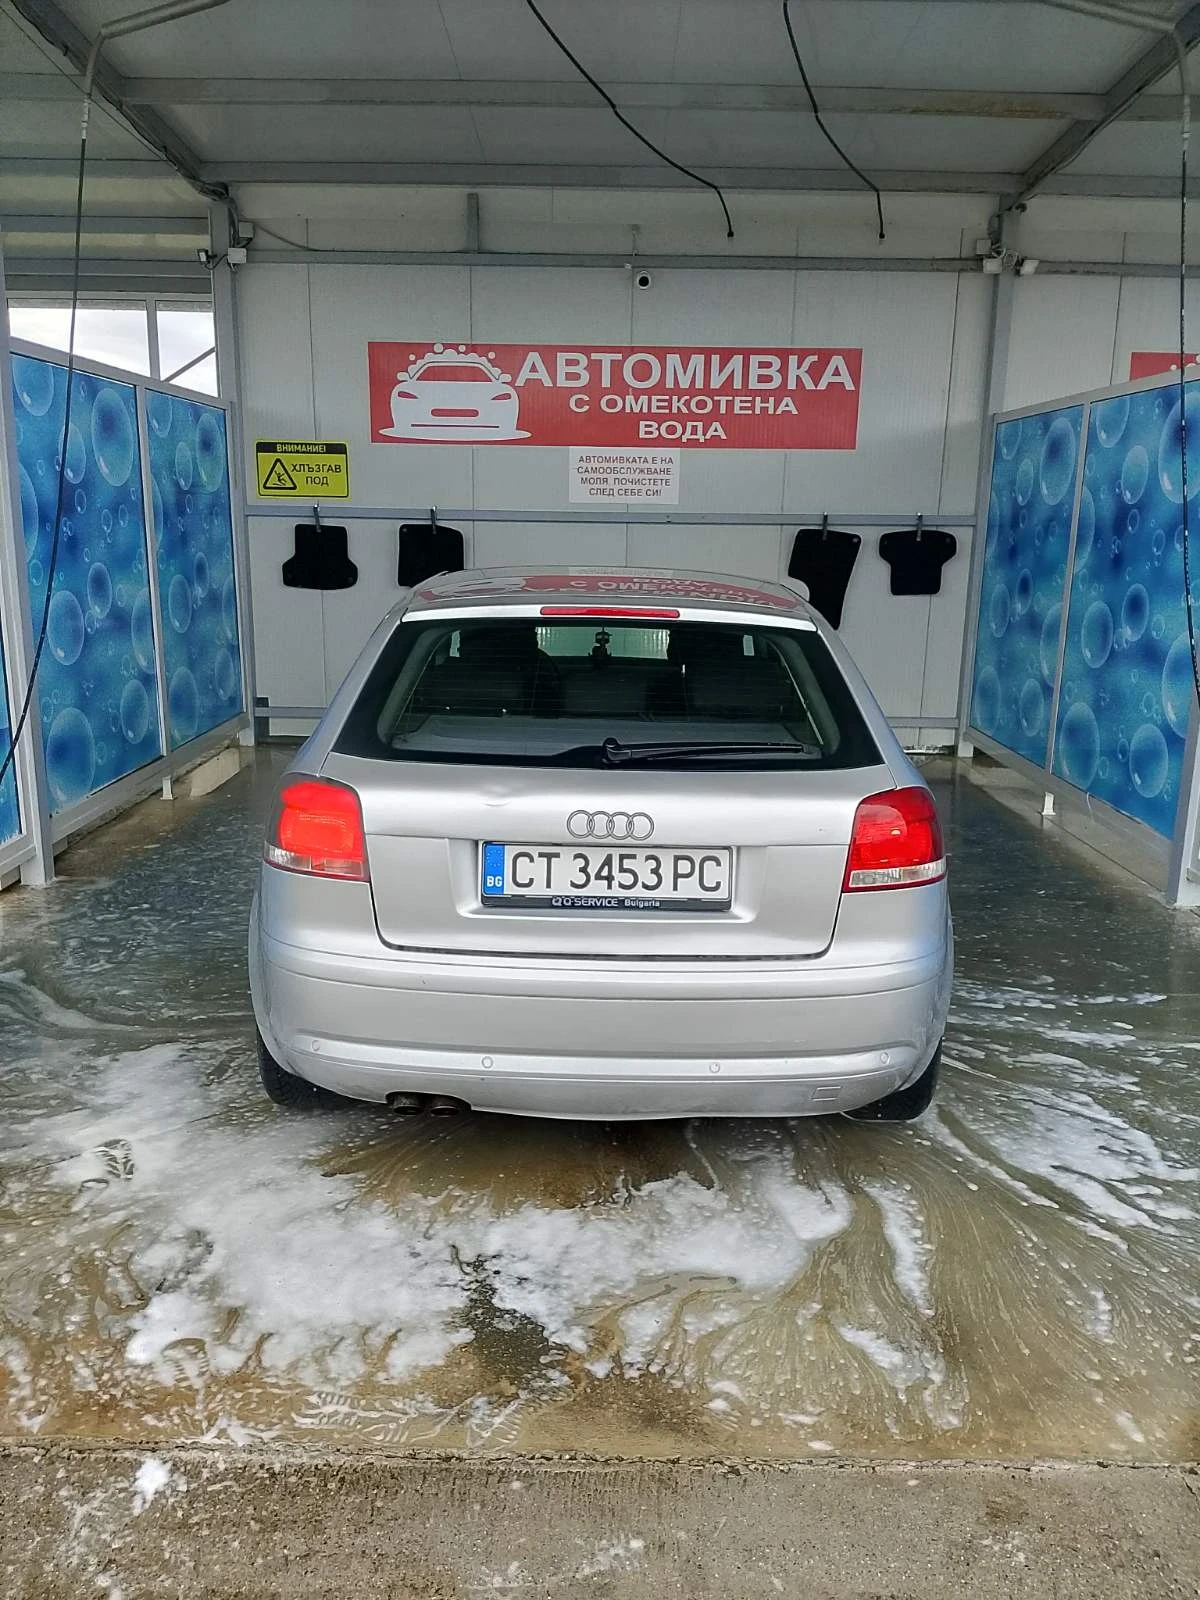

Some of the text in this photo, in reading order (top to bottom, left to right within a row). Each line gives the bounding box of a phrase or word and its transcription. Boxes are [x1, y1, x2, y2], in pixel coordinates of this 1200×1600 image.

[515, 351, 856, 390] АВТОМИВКА
[569, 394, 799, 415] С ОМЕКОТЕНА
[638, 420, 728, 443] ВОДА
[276, 443, 327, 453] ВНИМАНИЕ!
[578, 455, 674, 465] АВТОМИВКАТА Е НА
[291, 463, 342, 473] ХЛЪЗГАВ
[305, 476, 329, 486] ПОД
[613, 477, 671, 487] ПОЧИСТЕТЕ
[589, 487, 662, 497] СЛЕД СЕБЕ СИ!
[511, 851, 723, 893] CT 3453 PC
[486, 875, 503, 887] BG
[624, 899, 660, 909] Bulgaria
